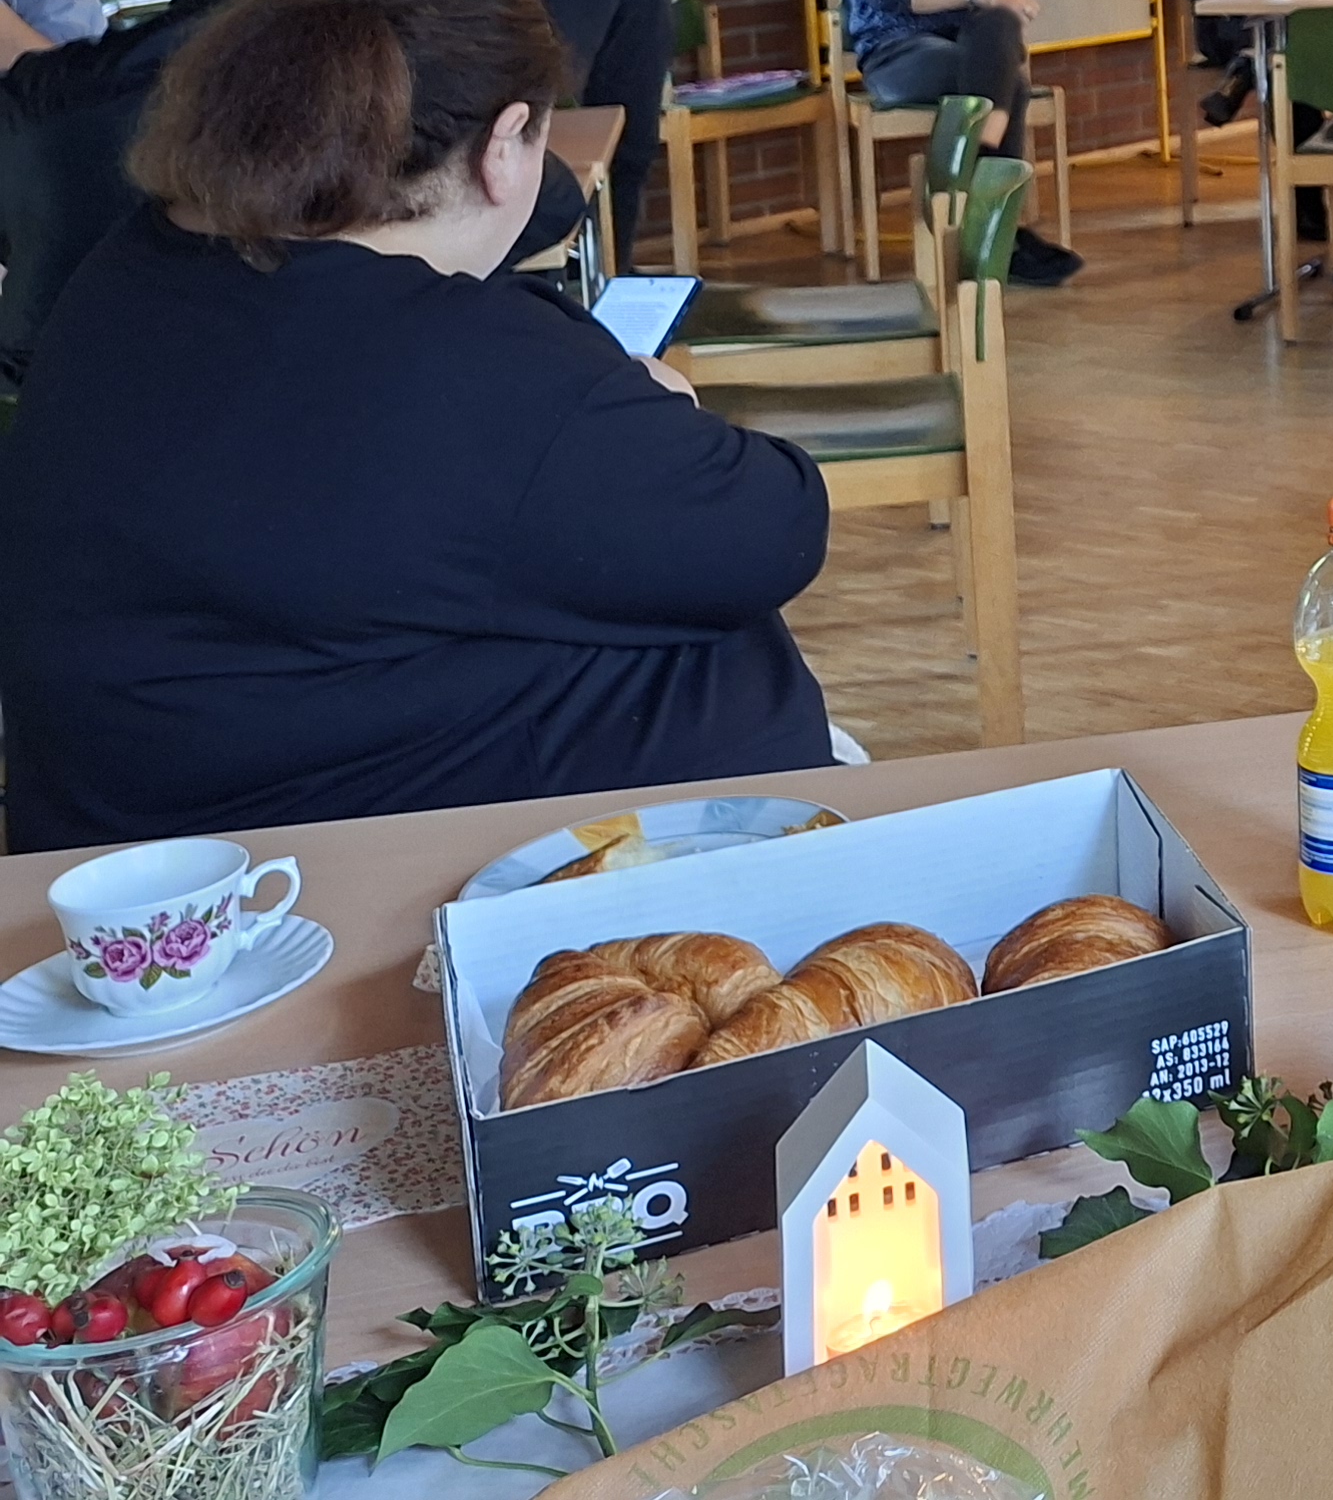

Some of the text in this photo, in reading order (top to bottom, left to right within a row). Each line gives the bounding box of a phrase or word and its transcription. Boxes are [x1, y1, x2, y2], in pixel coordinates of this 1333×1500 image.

[1150, 1052, 1229, 1087] AN: 2013-12
[1156, 1052, 1178, 1069] AS:
[1210, 1068, 1231, 1090] ml
[203, 1126, 367, 1171] Schön
